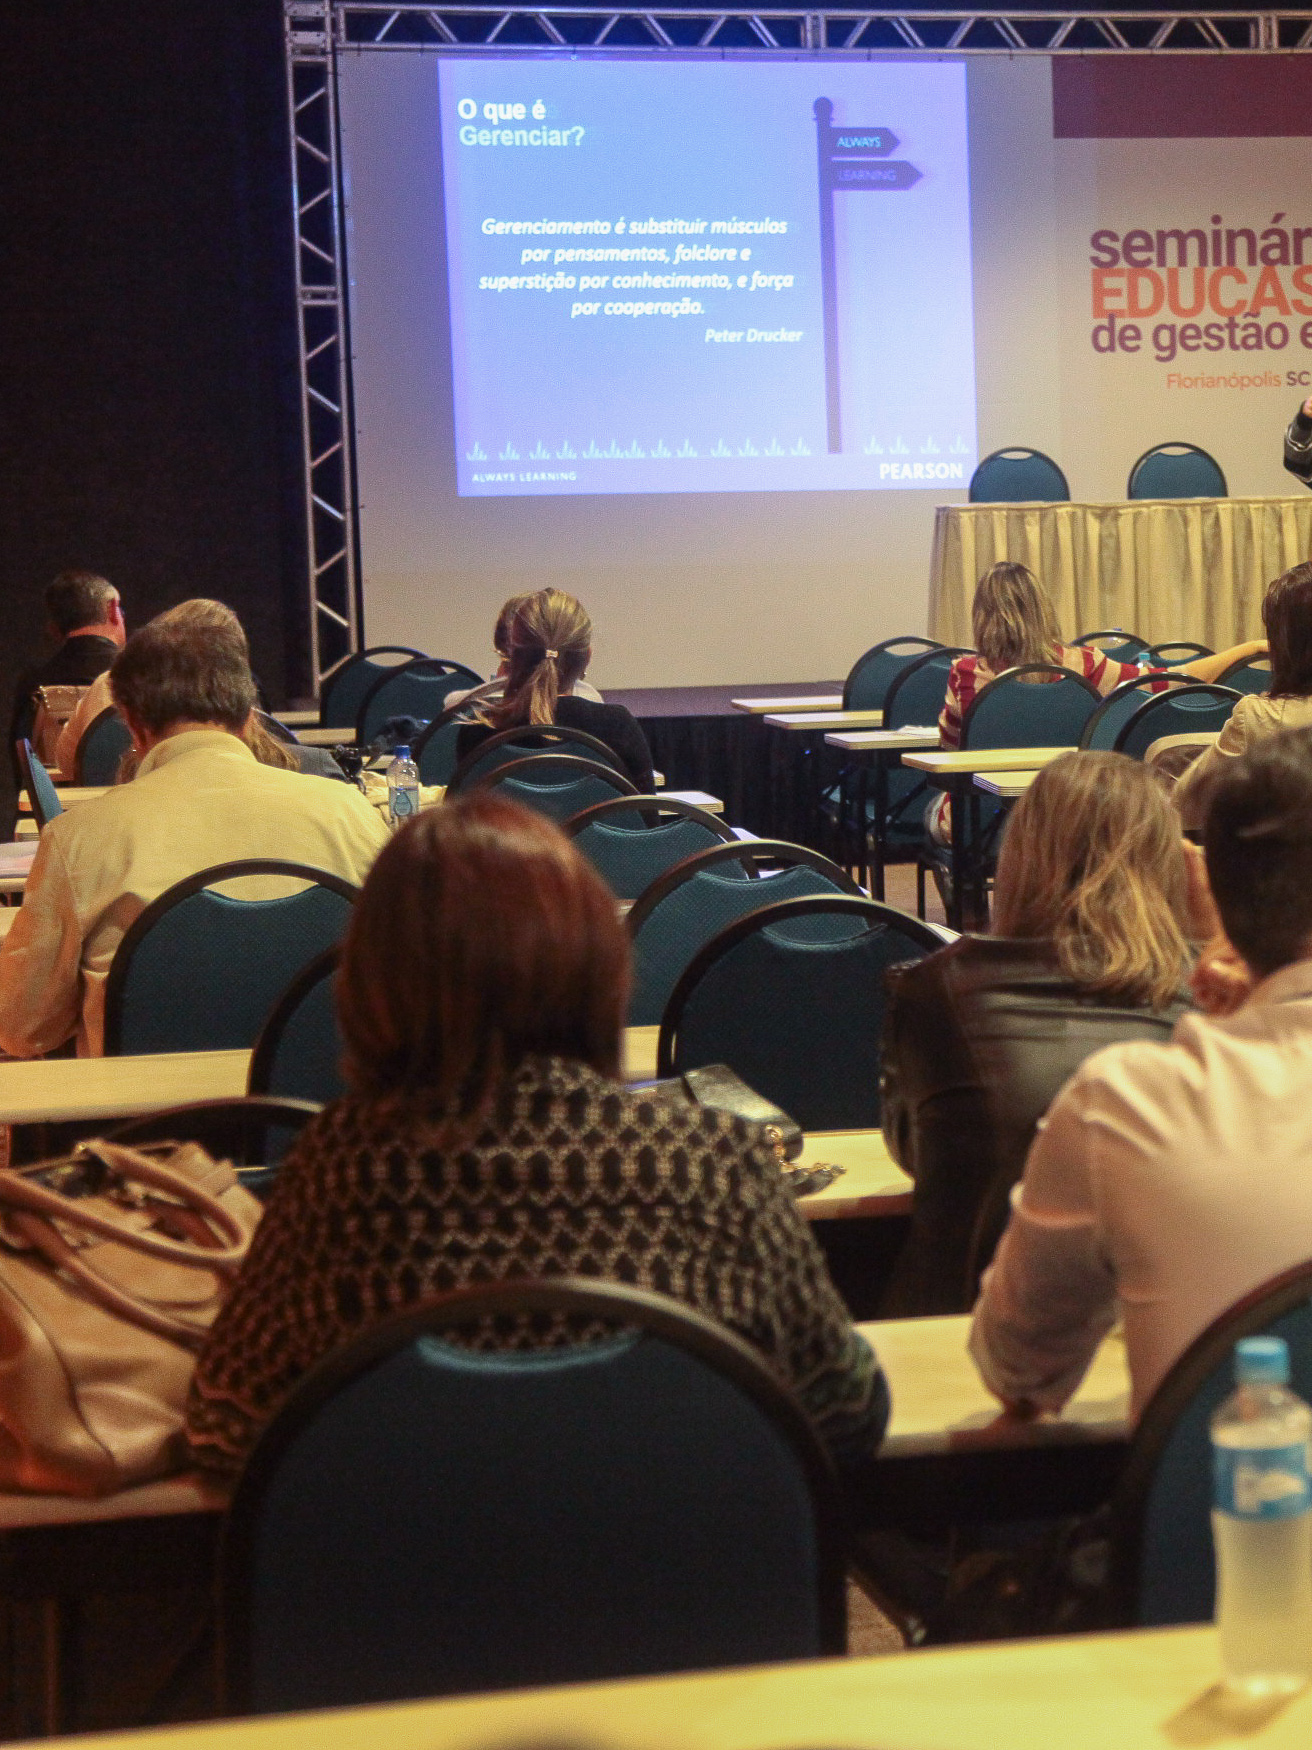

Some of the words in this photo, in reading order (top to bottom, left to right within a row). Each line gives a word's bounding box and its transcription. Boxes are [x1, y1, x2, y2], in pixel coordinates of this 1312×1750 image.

[457, 98, 477, 120] O
[483, 102, 527, 126] que
[532, 98, 546, 120] é
[459, 125, 585, 147] Gerenciar?
[837, 136, 882, 149] ALWAYS
[481, 218, 612, 235] Gerenciamento
[614, 216, 627, 235] é
[628, 217, 708, 235] substituir
[710, 216, 788, 235] músculos
[521, 248, 551, 265] por
[554, 246, 670, 265] pensamentos,
[672, 243, 737, 265] folclore
[740, 248, 752, 261] e
[478, 271, 577, 293] superstição
[579, 275, 610, 292] por
[612, 271, 733, 290] conhecimento,
[737, 275, 748, 288] e
[749, 270, 794, 291] força
[570, 302, 602, 319] por
[604, 297, 705, 318] cooperação.
[705, 328, 744, 343] Peter
[746, 327, 804, 343] Drucker
[1091, 312, 1143, 353] de
[1152, 310, 1290, 363] gestão
[1166, 370, 1282, 390] Florianópolis
[1286, 370, 1311, 387] SC
[472, 472, 516, 482] ALWAYS
[519, 471, 577, 482] LEARNING
[880, 462, 964, 480] PEARSON
